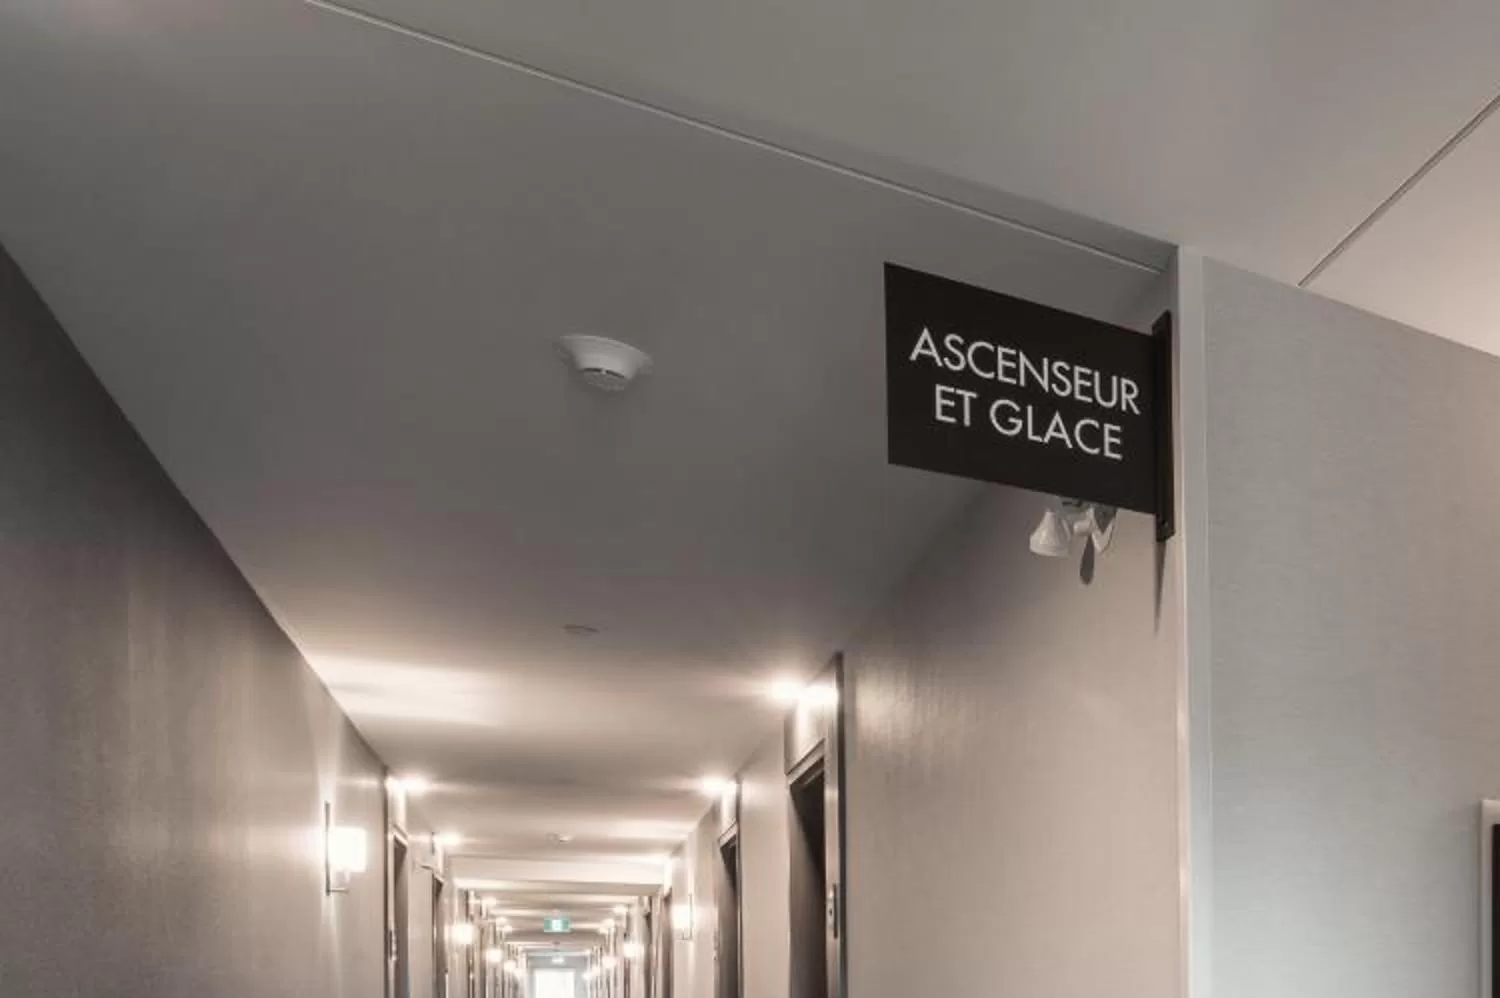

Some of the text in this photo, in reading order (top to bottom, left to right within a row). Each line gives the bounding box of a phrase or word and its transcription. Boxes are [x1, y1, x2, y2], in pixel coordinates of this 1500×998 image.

[909, 326, 1141, 415] ASCENSEUR
[934, 383, 1124, 461] ET GLACE
